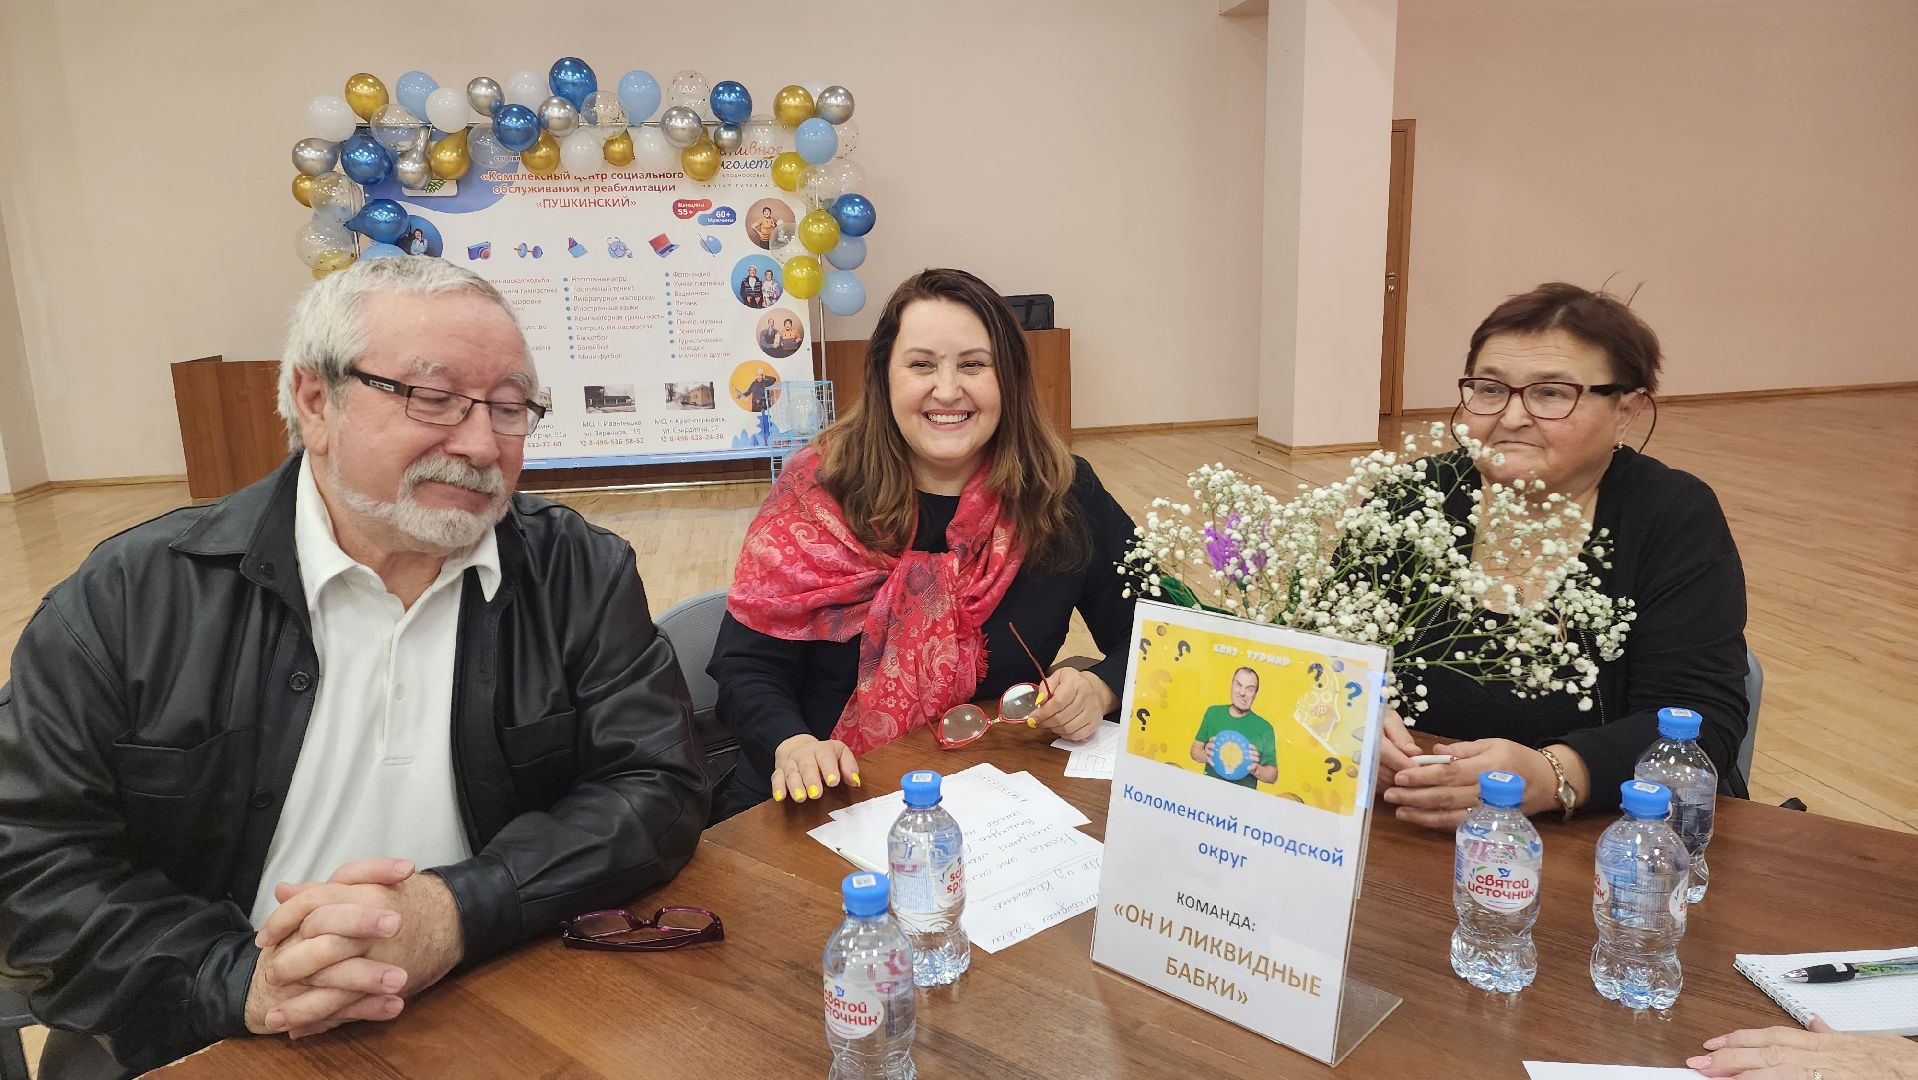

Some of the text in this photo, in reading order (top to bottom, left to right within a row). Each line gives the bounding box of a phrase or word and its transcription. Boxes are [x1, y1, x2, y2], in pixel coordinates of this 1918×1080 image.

[493, 184, 580, 196] обслуживания
[594, 183, 676, 195] реабилитации
[611, 172, 684, 181] социального
[536, 196, 637, 208] «ПУШКИНСКИЙ»
[1123, 783, 1344, 867] Коломенский городской
[1198, 842, 1248, 868] округ
[1176, 891, 1256, 932] КОМАНДА:
[1114, 903, 1323, 998] «ОН И ЛИКВИДНЫЕ
[1165, 956, 1249, 1005] БАБКИ»
